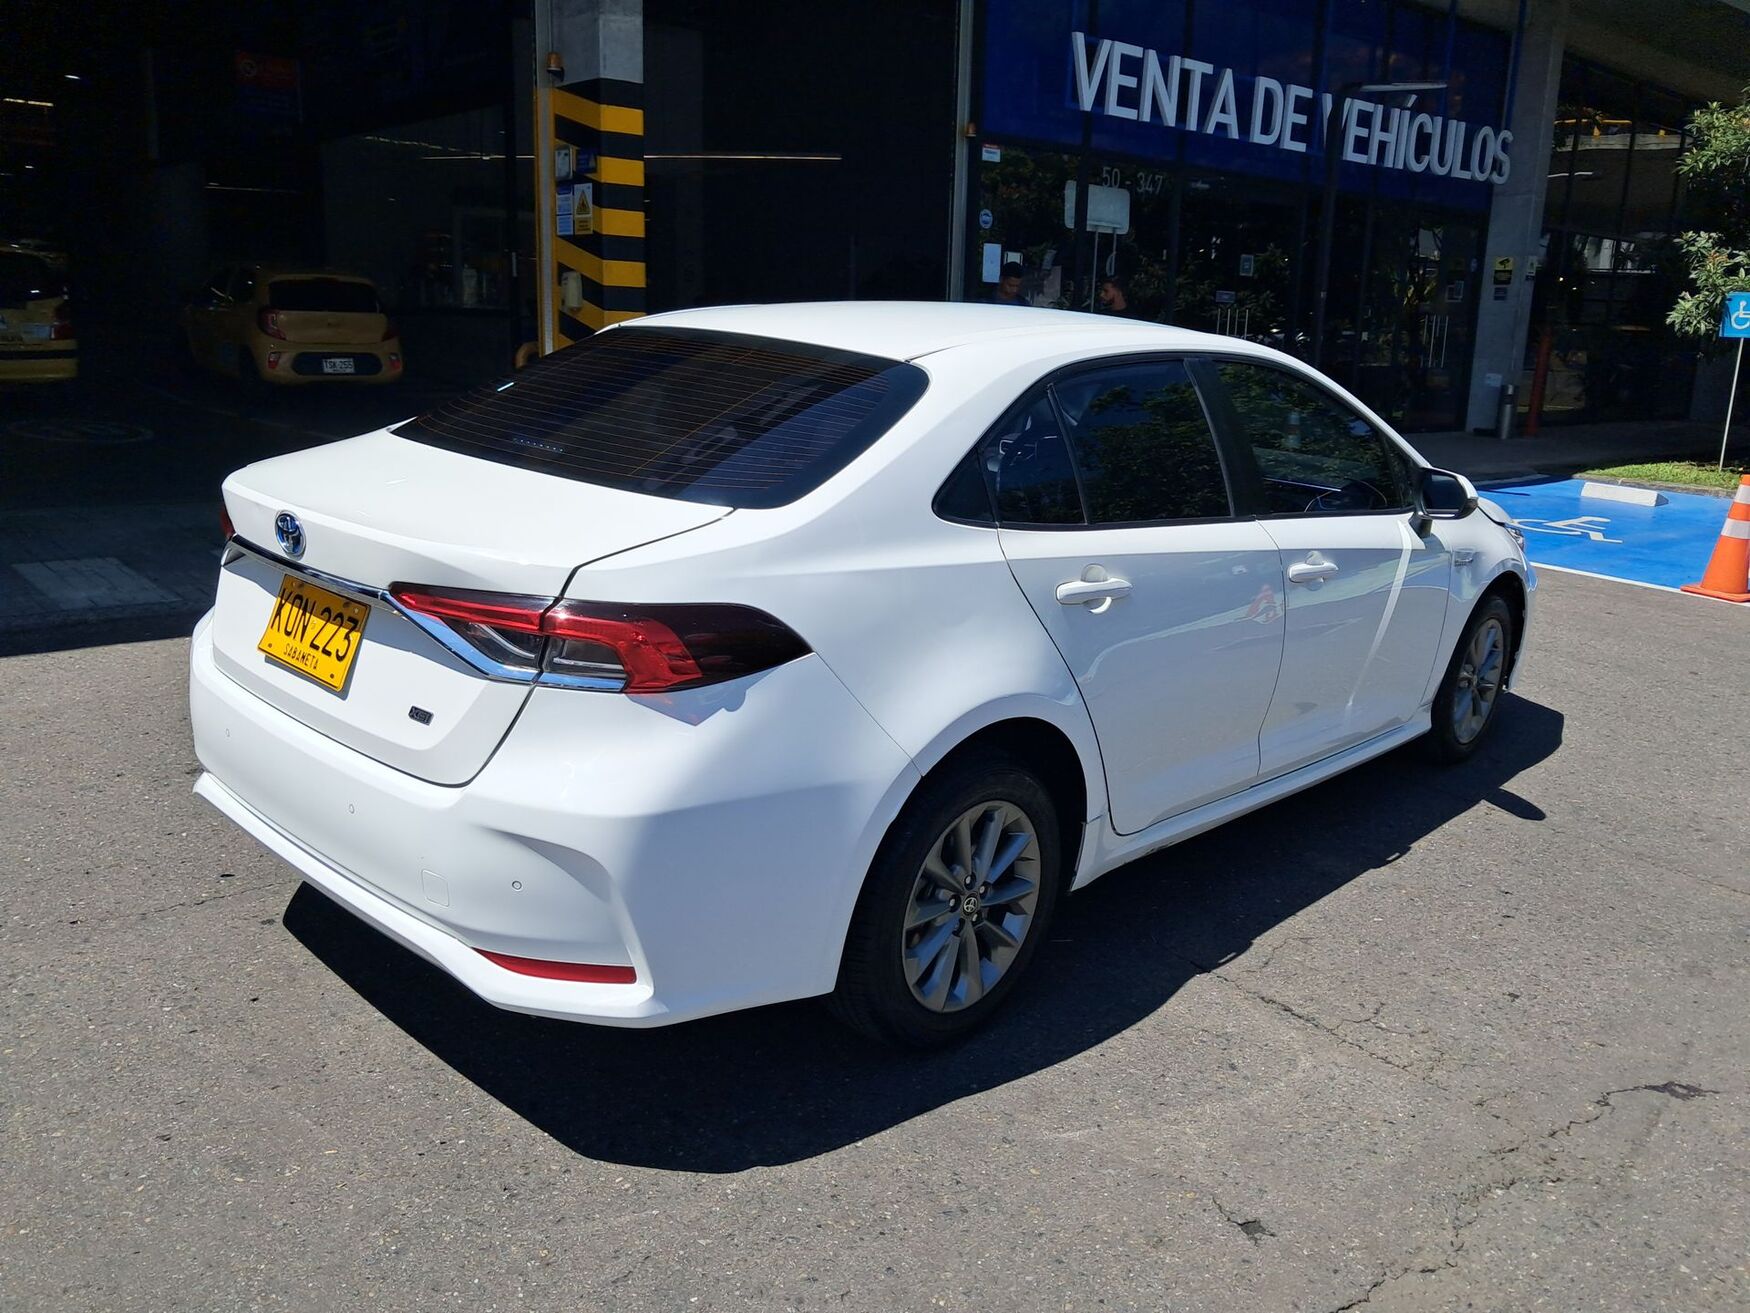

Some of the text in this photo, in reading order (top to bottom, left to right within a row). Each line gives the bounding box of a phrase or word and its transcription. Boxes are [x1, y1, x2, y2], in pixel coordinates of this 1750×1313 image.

[1071, 31, 1240, 140] VENTA
[1249, 75, 1314, 153] DE
[1101, 166, 1121, 188] 50
[1136, 171, 1164, 195] 347
[270, 588, 359, 663] KON 223
[283, 643, 319, 670] SABANETA
